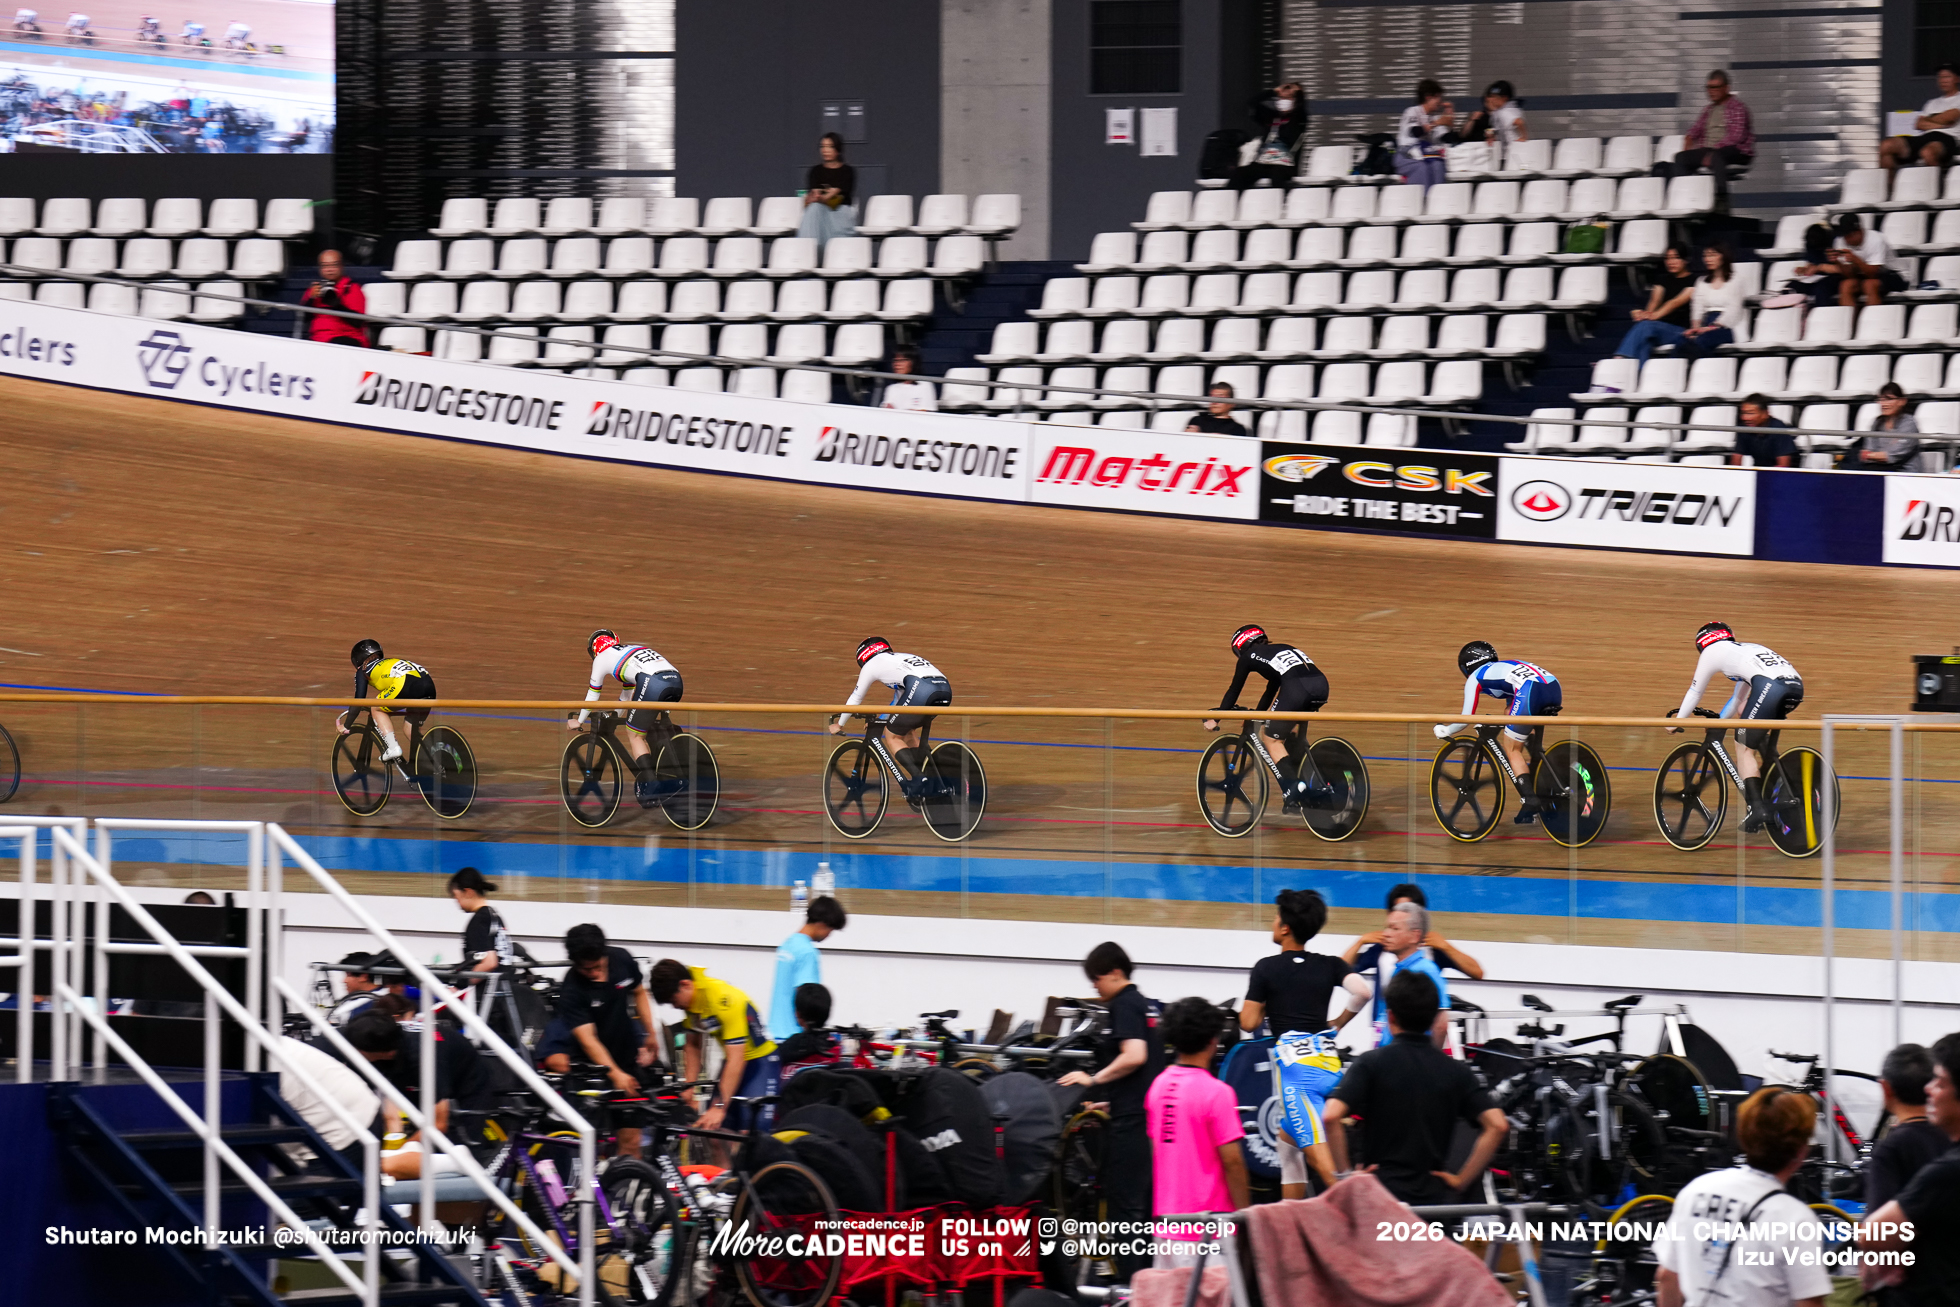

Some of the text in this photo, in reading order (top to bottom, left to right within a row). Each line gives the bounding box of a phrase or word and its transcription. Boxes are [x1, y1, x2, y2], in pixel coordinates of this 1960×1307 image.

[201, 356, 315, 400] Cyclers
[354, 371, 565, 431] BRIDGESTONE
[586, 402, 793, 457] BRIDGESTONE
[814, 427, 1019, 479] BRIDGESTONE
[1035, 446, 1253, 497] Matrix
[1343, 461, 1495, 497] CSK
[1293, 495, 1462, 525] RIDE THE BEST
[1577, 488, 1742, 528] TRIGON
[1277, 651, 1300, 667] 214
[1756, 651, 1779, 667] 228
[871, 737, 904, 782] BRIDGESTONE
[1284, 1086, 1306, 1134] KURABO
